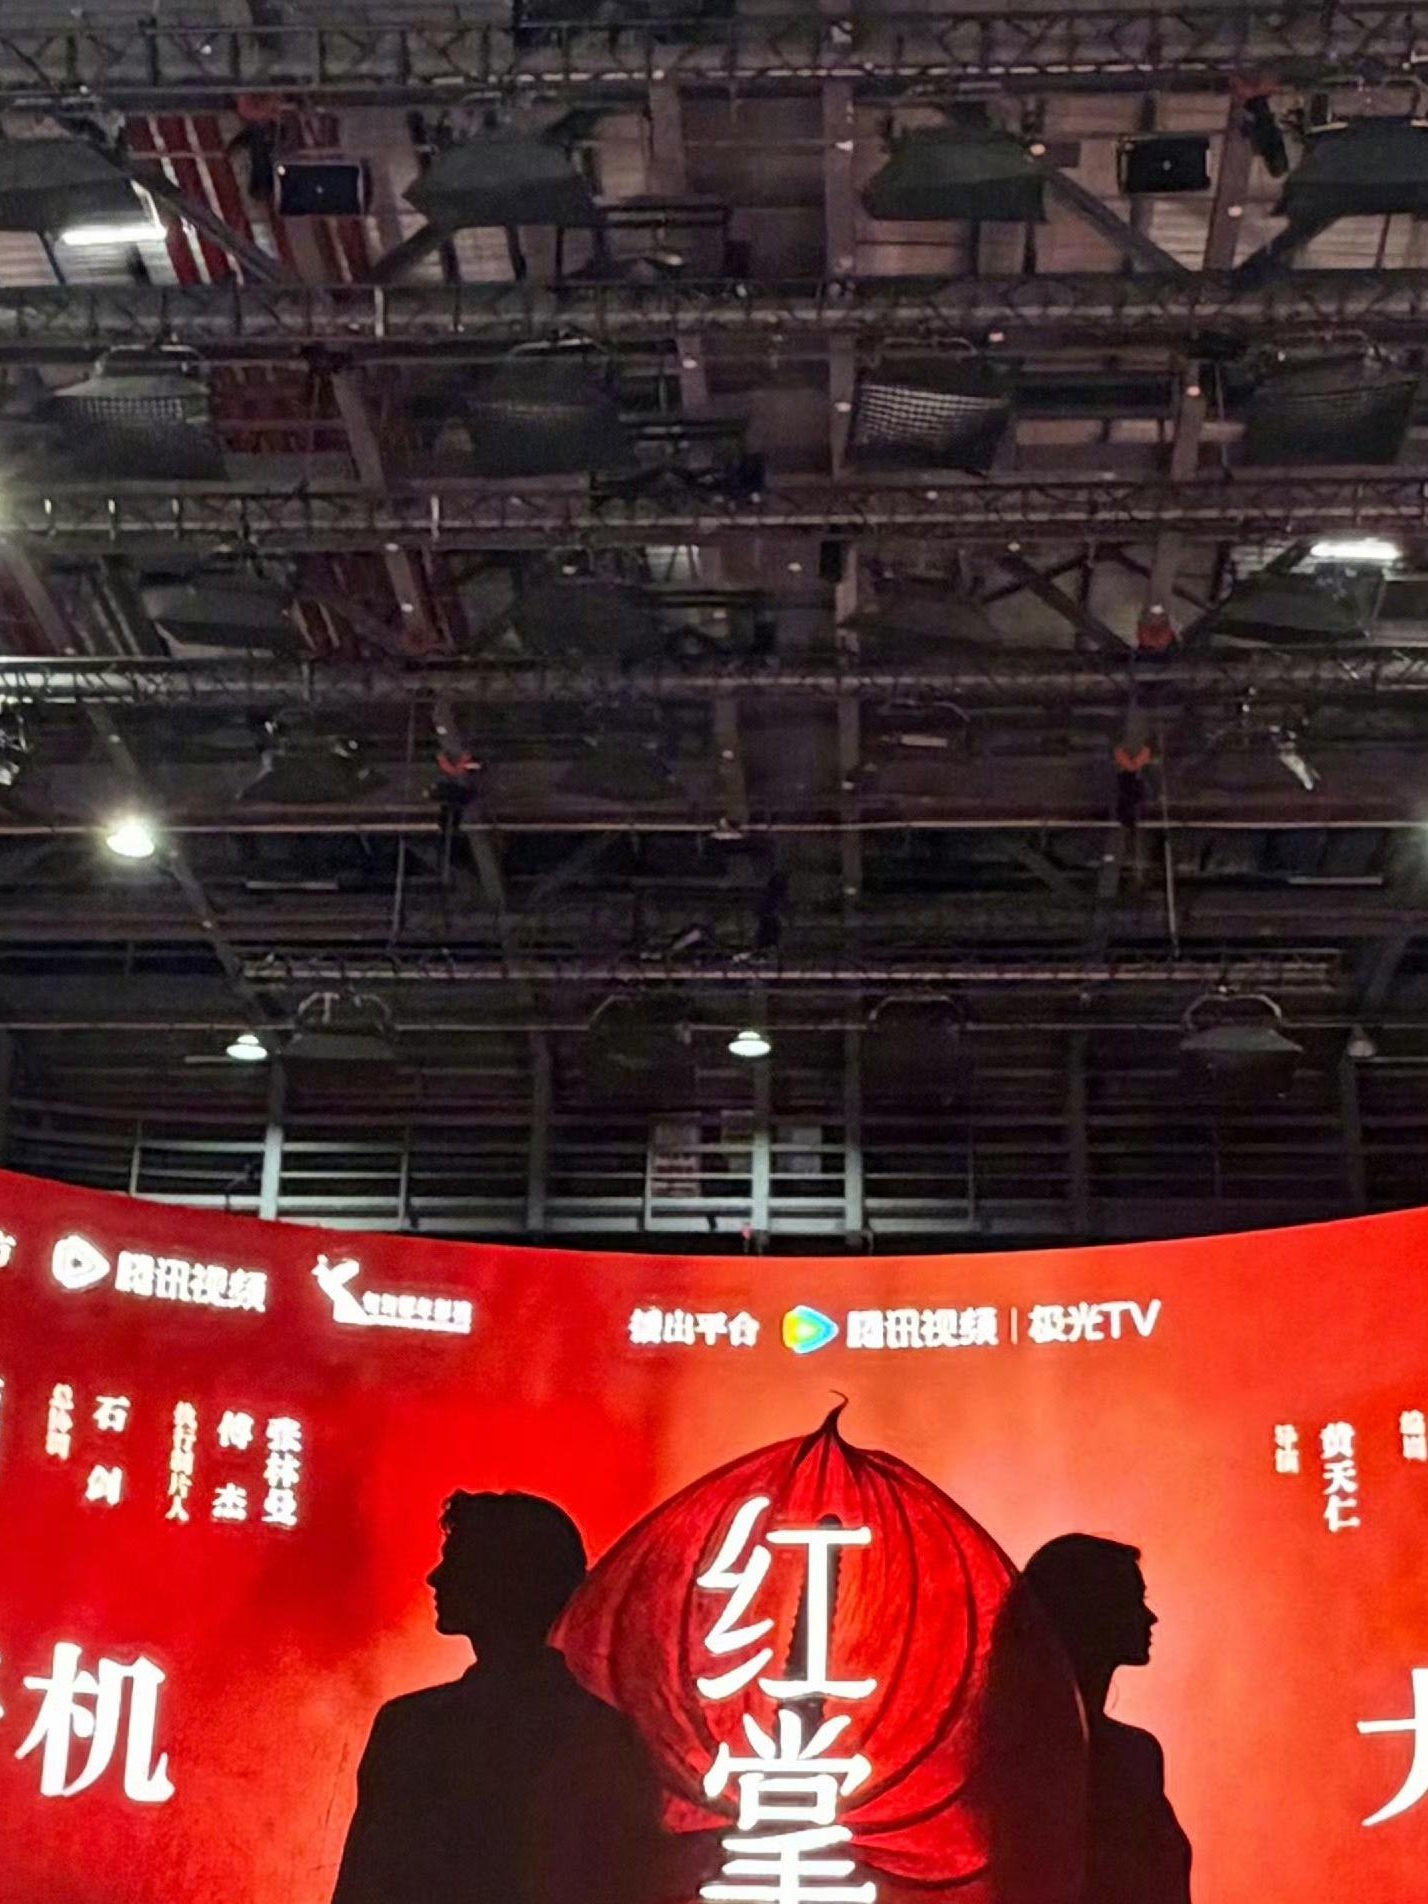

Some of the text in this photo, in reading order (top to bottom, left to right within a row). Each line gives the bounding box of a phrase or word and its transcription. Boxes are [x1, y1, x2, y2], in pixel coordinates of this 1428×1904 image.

[115, 1251, 268, 1313] 腾讯视频
[846, 1307, 999, 1349] 腾讯视频
[1028, 1299, 1161, 1343] 极光TV
